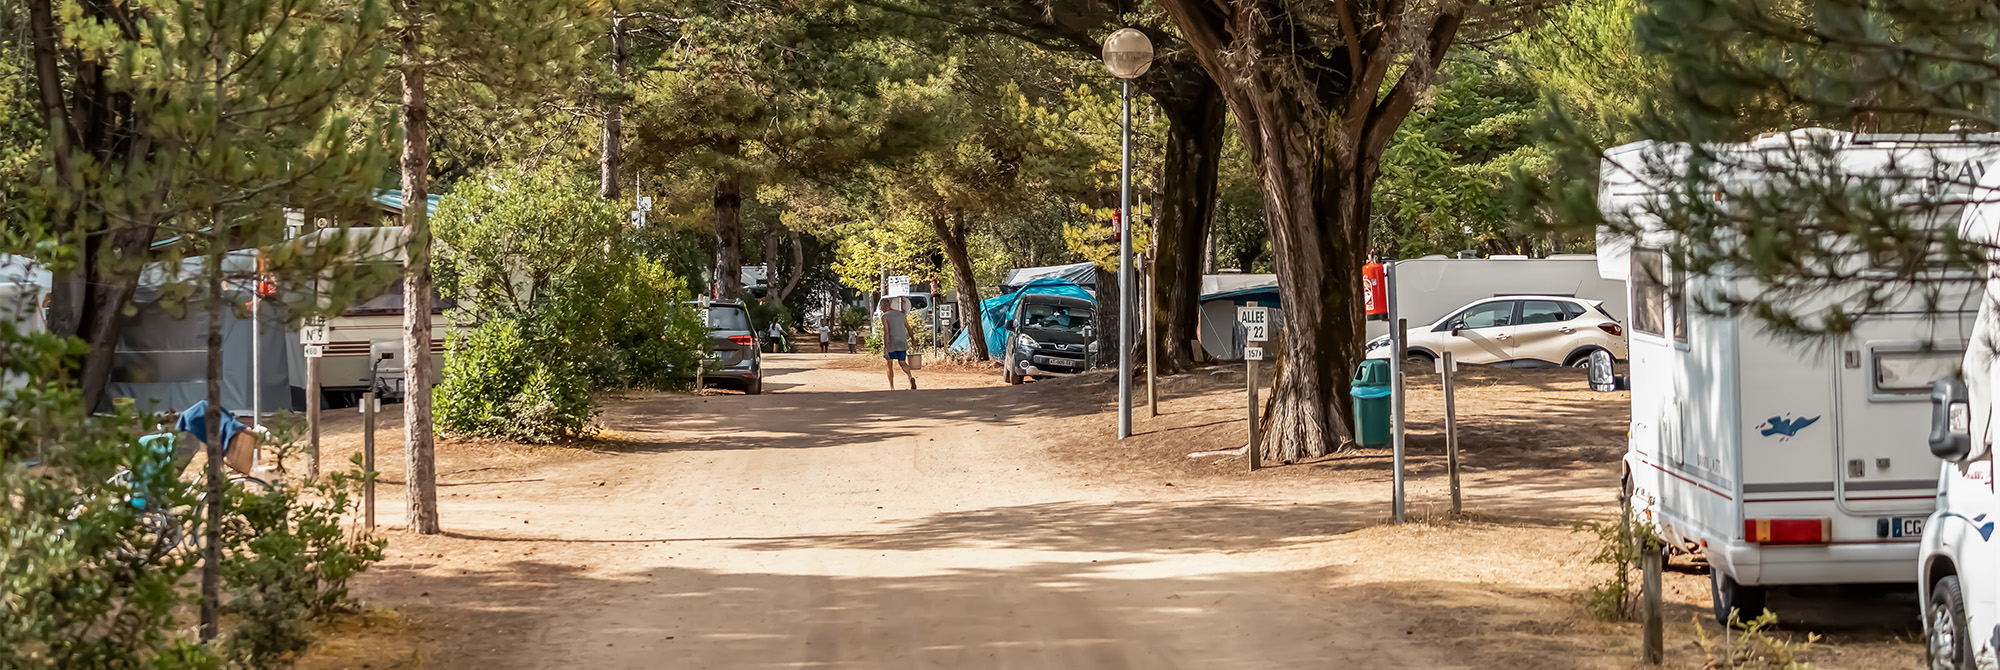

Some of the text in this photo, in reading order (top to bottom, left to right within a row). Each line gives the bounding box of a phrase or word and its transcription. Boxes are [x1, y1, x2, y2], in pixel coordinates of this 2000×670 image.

[1241, 311, 1264, 323] ALLEE
[317, 329, 323, 341] 9
[1253, 326, 1264, 338] 22
[1904, 519, 1922, 535] CG
